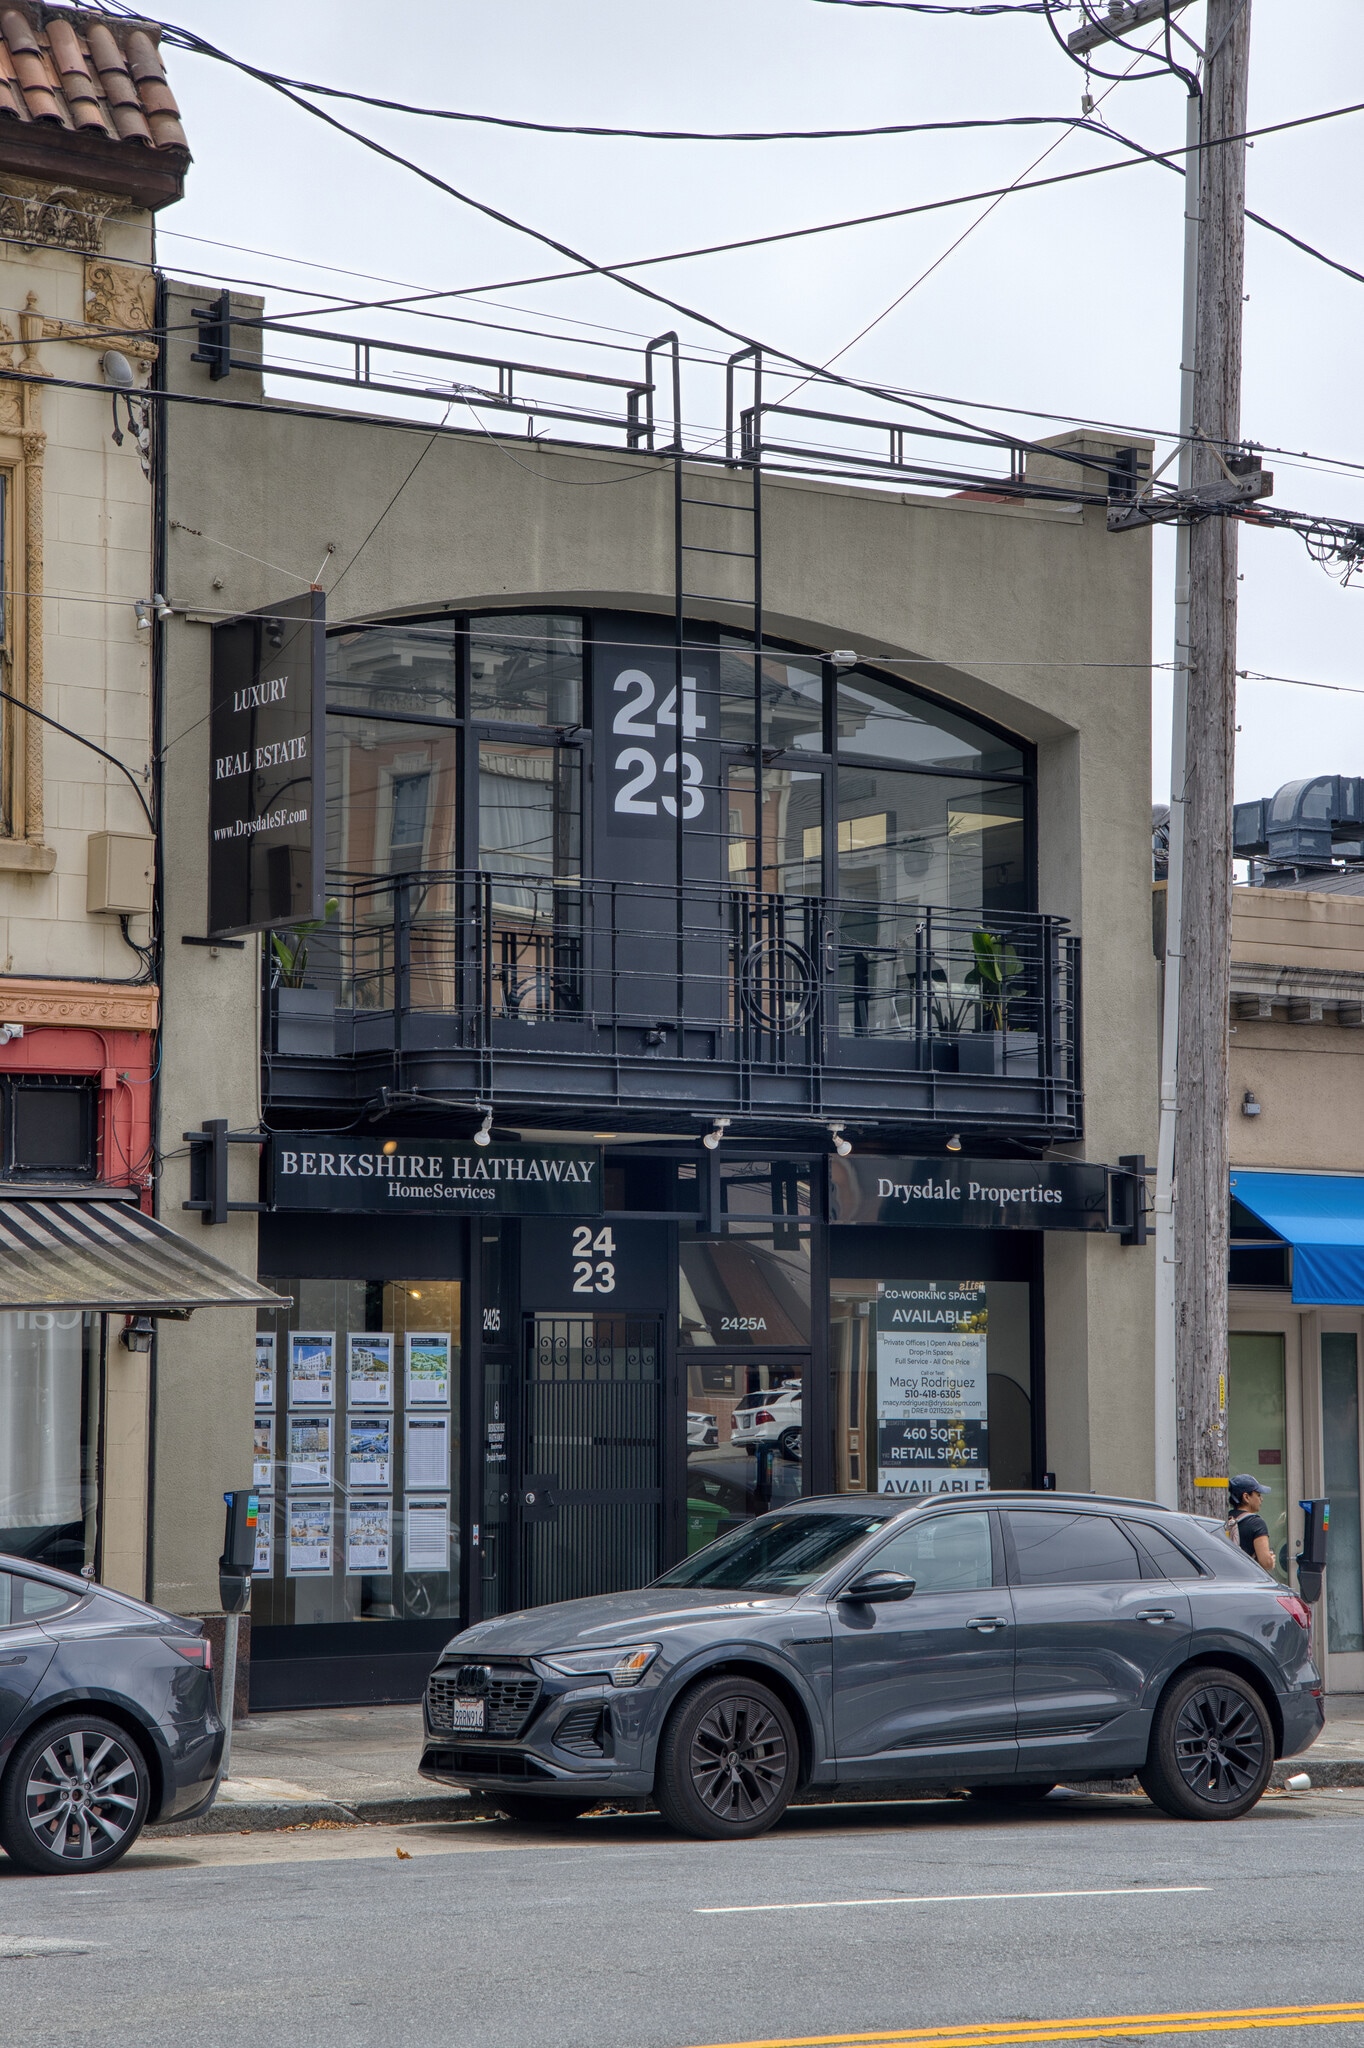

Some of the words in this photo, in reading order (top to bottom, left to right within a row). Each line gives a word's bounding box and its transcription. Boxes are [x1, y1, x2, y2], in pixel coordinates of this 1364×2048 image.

[233, 676, 288, 713] LUXURY
[613, 669, 706, 742] 24
[215, 751, 251, 779] REAL
[255, 736, 307, 770] ESTATE
[614, 747, 705, 819] 23
[213, 808, 307, 841] www.DrysdaleSF.com
[281, 1151, 443, 1179] BERKSHIRE
[452, 1157, 595, 1183] HATHAWAY
[388, 1182, 495, 1199] HomeServices
[877, 1178, 960, 1204] Drysdale
[968, 1182, 1062, 1207] Properties
[572, 1226, 616, 1257] 24
[572, 1261, 615, 1293] 23
[884, 1290, 946, 1300] CO-WORKING
[948, 1291, 978, 1301] SPACE
[483, 1308, 501, 1331] 2425
[721, 1317, 767, 1331] 2425A
[892, 1309, 972, 1324] AVAILABLE
[909, 1349, 932, 1357] Drop-In
[932, 1349, 954, 1357] Spaces
[930, 1341, 946, 1349] Open
[889, 1377, 918, 1389] Macy
[921, 1377, 975, 1390] Rodriguez
[904, 1390, 961, 1399] 510-418-6305
[903, 1428, 927, 1440] 460
[930, 1428, 963, 1442] SQFT
[891, 1448, 935, 1459] RETAIL
[937, 1448, 978, 1459] SPACE
